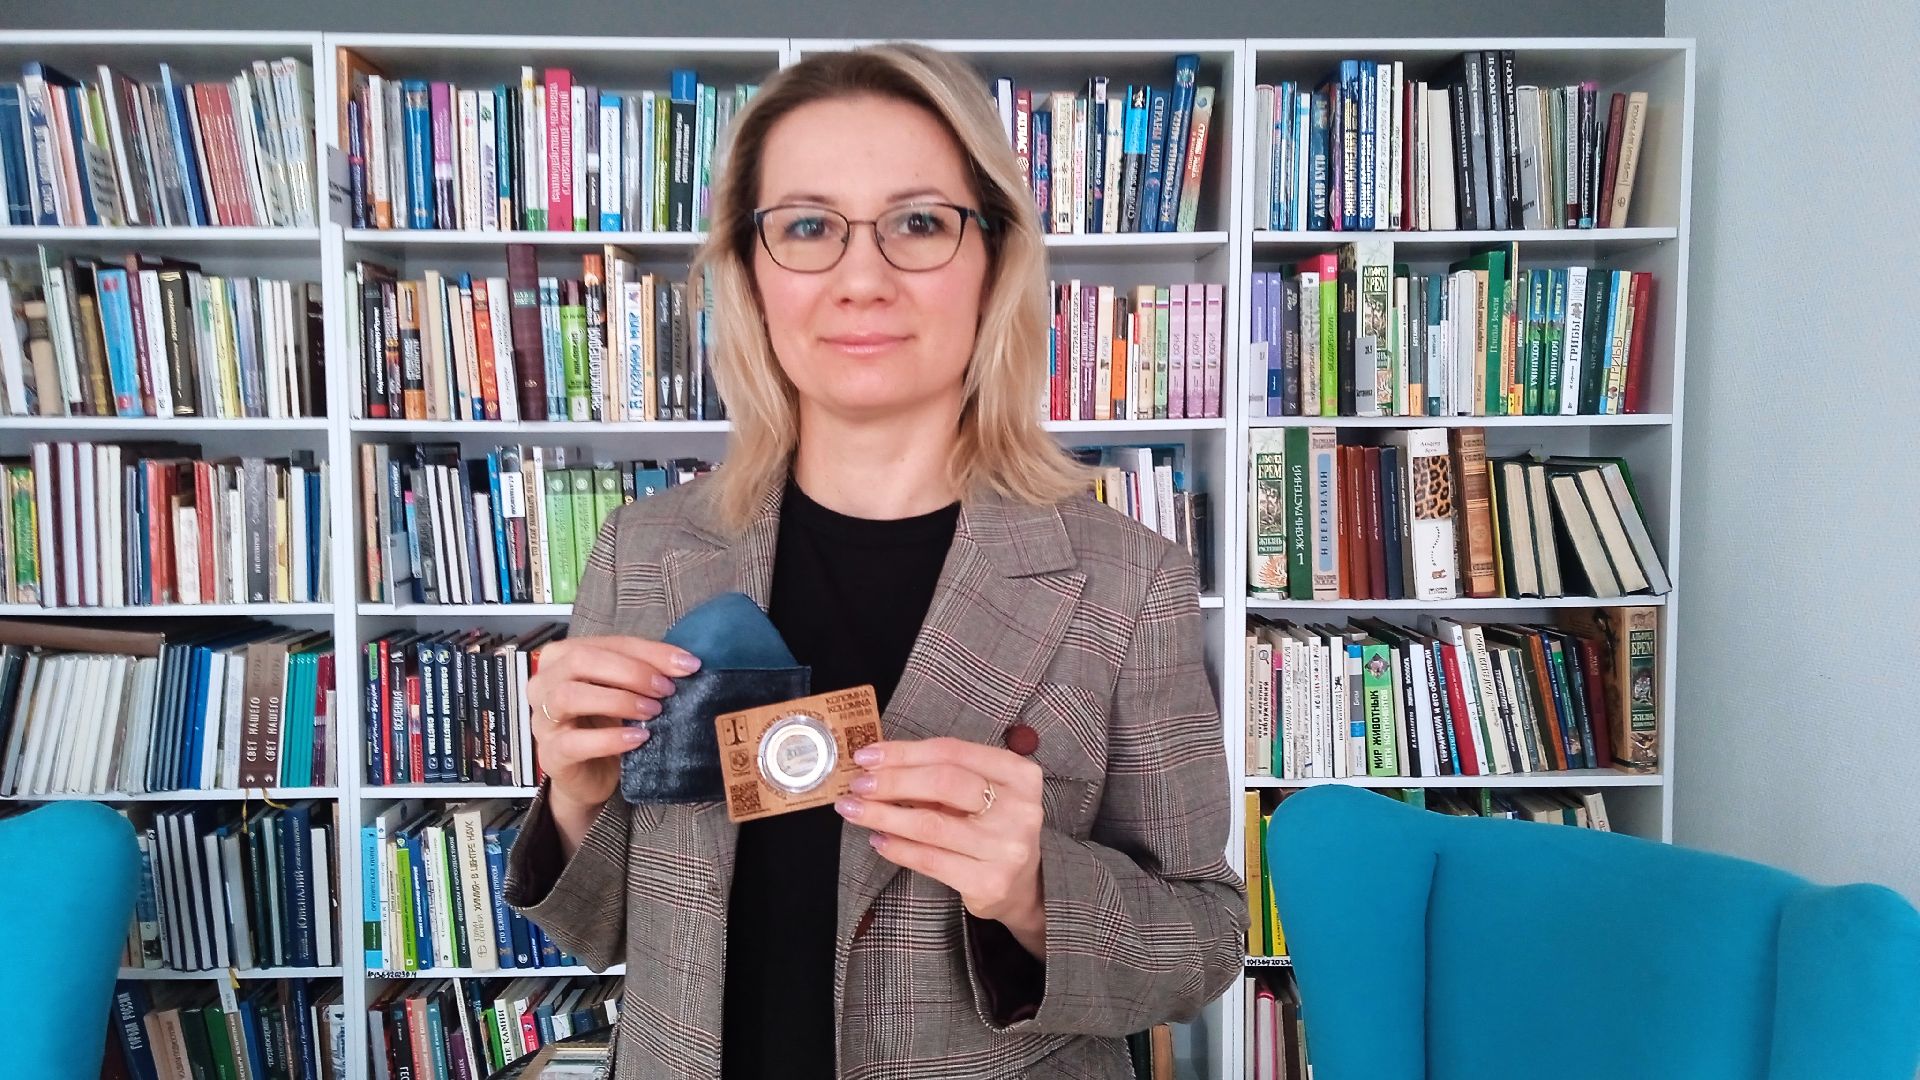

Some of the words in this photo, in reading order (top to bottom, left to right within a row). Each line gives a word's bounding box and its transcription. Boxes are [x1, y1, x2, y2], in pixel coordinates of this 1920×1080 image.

[1151, 96, 1165, 141] СТРАНЫ
[1569, 320, 1581, 362] ГРИБЫ
[1609, 336, 1623, 382] ГРИБЫ
[1529, 340, 1541, 387] БОТАНИКА
[1547, 340, 1560, 387] БОТАНИКА
[1292, 464, 1303, 517] РАСТЕНИЙ
[1295, 516, 1305, 551] ЖИЗНЬ
[1631, 640, 1656, 656] БРЕМ
[392, 689, 405, 731] ВСЕЛЕННАЯ
[424, 666, 436, 715] СОЛНЕЧНАЯ
[441, 666, 453, 715] СОЛНЕЧНАЯ
[826, 689, 871, 705] КОЛОМНА
[827, 698, 873, 714] KOLOMNA
[248, 696, 261, 736] НАШЕГО
[266, 696, 280, 736] НАШЕГО
[427, 716, 437, 755] СИСТЕМА
[444, 716, 453, 755] СИСТЕМА
[1369, 689, 1382, 746] ЖИВОТНЫХ
[1379, 689, 1392, 746] КОНТИНЕНТОВ
[246, 740, 259, 763] СВЕТ
[264, 740, 277, 763] СВЕТ
[1372, 749, 1384, 769] МИР
[1383, 747, 1394, 769] ПЯТИ
[464, 820, 475, 841] НАУК
[116, 992, 137, 1020] РОССИИ
[124, 1022, 143, 1050] ГОРОДА
[498, 1009, 510, 1045] КАМНИ
